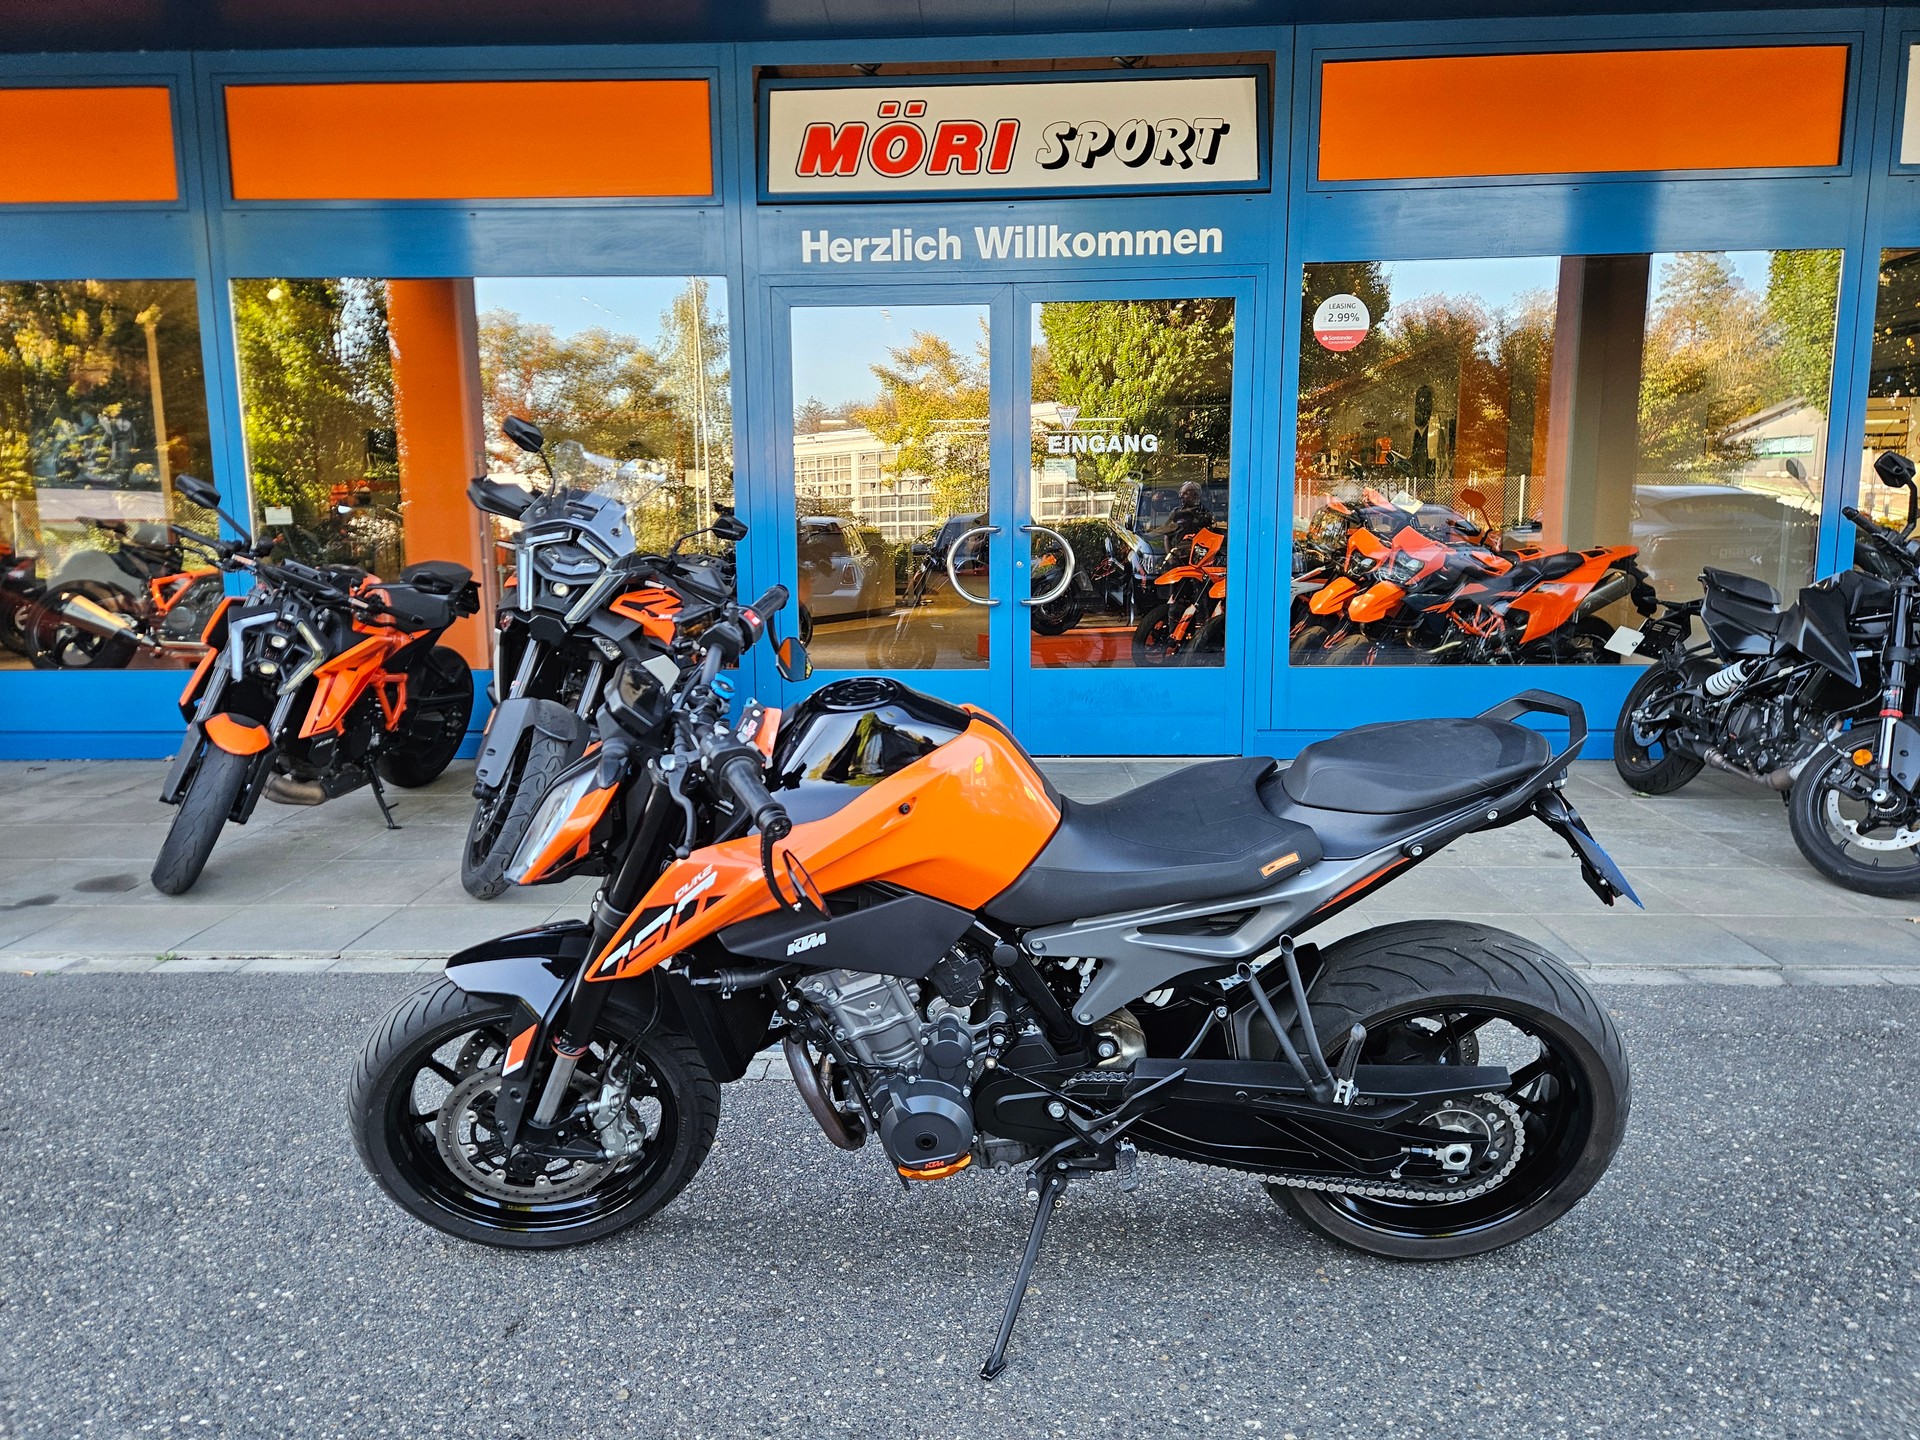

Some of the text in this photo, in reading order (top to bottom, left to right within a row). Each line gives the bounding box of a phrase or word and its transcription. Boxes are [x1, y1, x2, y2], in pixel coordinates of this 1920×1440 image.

[795, 100, 1230, 178] MÖRI SPORT
[801, 224, 1223, 264] Herzlich Willkommen
[1328, 312, 1360, 322] 2.99%
[1048, 434, 1158, 454] EINGANG
[674, 864, 713, 899] DUKE
[786, 932, 827, 957] KTM
[925, 1160, 945, 1169] KTM
